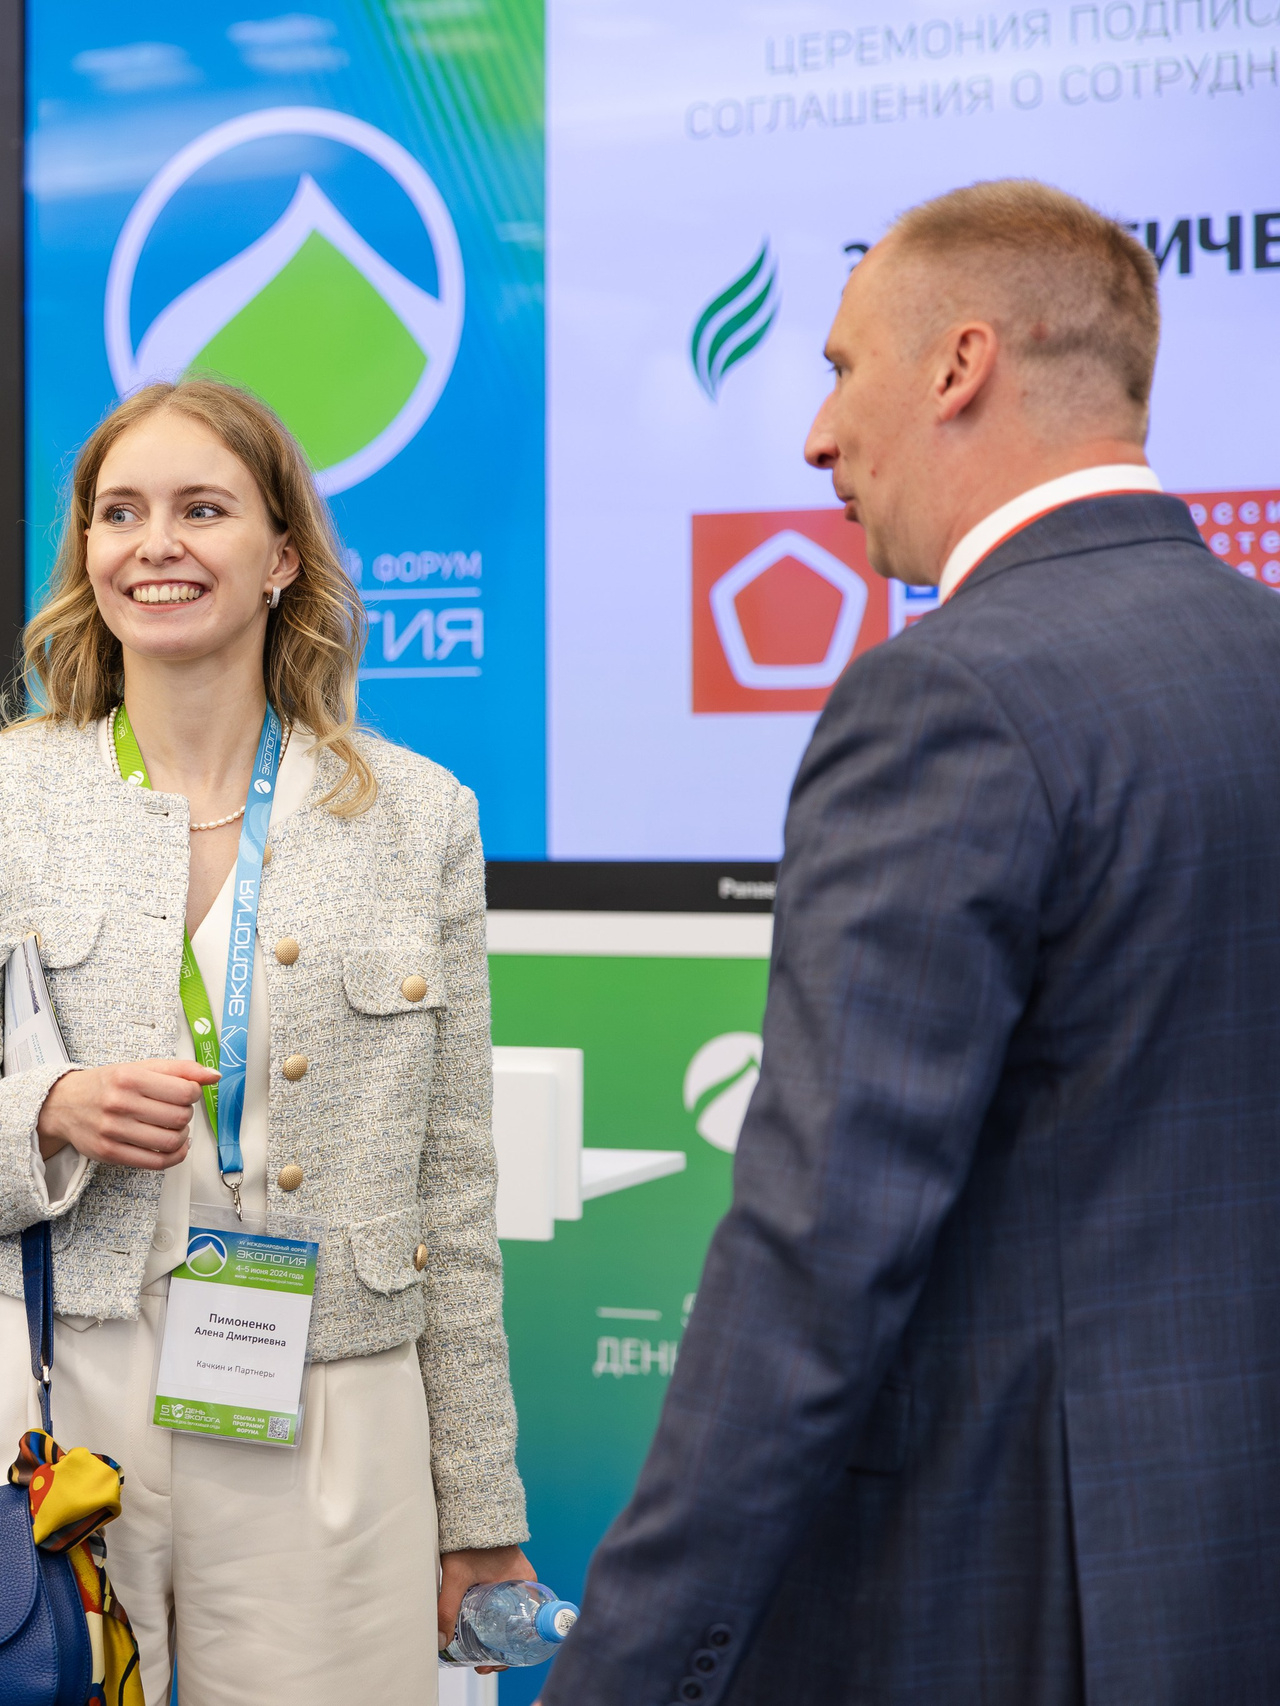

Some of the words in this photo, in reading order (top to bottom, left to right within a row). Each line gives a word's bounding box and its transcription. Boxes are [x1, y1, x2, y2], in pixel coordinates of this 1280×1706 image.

[765, 8, 1051, 79] ЦЕРЕМОНИЯ
[1071, 0, 1280, 46] ПОДПИС
[684, 74, 994, 141] СОГЛАШЕНИЯ
[1010, 68, 1043, 111] О
[372, 550, 482, 583] ФОРУМ
[261, 718, 278, 776] ЭКОЛОГИЯ
[228, 879, 256, 1017] ЭКОЛОГИЯ
[236, 1249, 307, 1267] ЭКОЛОГИЯ
[269, 1269, 288, 1278] 2024
[288, 1272, 305, 1280] года
[208, 1313, 277, 1332] Пимоненко
[194, 1326, 225, 1339] Алена
[226, 1331, 287, 1347] Дмитриевна
[196, 1360, 226, 1371] Качкин
[234, 1365, 275, 1379] Партнеры
[161, 1404, 170, 1414] 5
[184, 1407, 206, 1416] ДЕНЬ
[184, 1414, 221, 1424] ЭКОЛОГА
